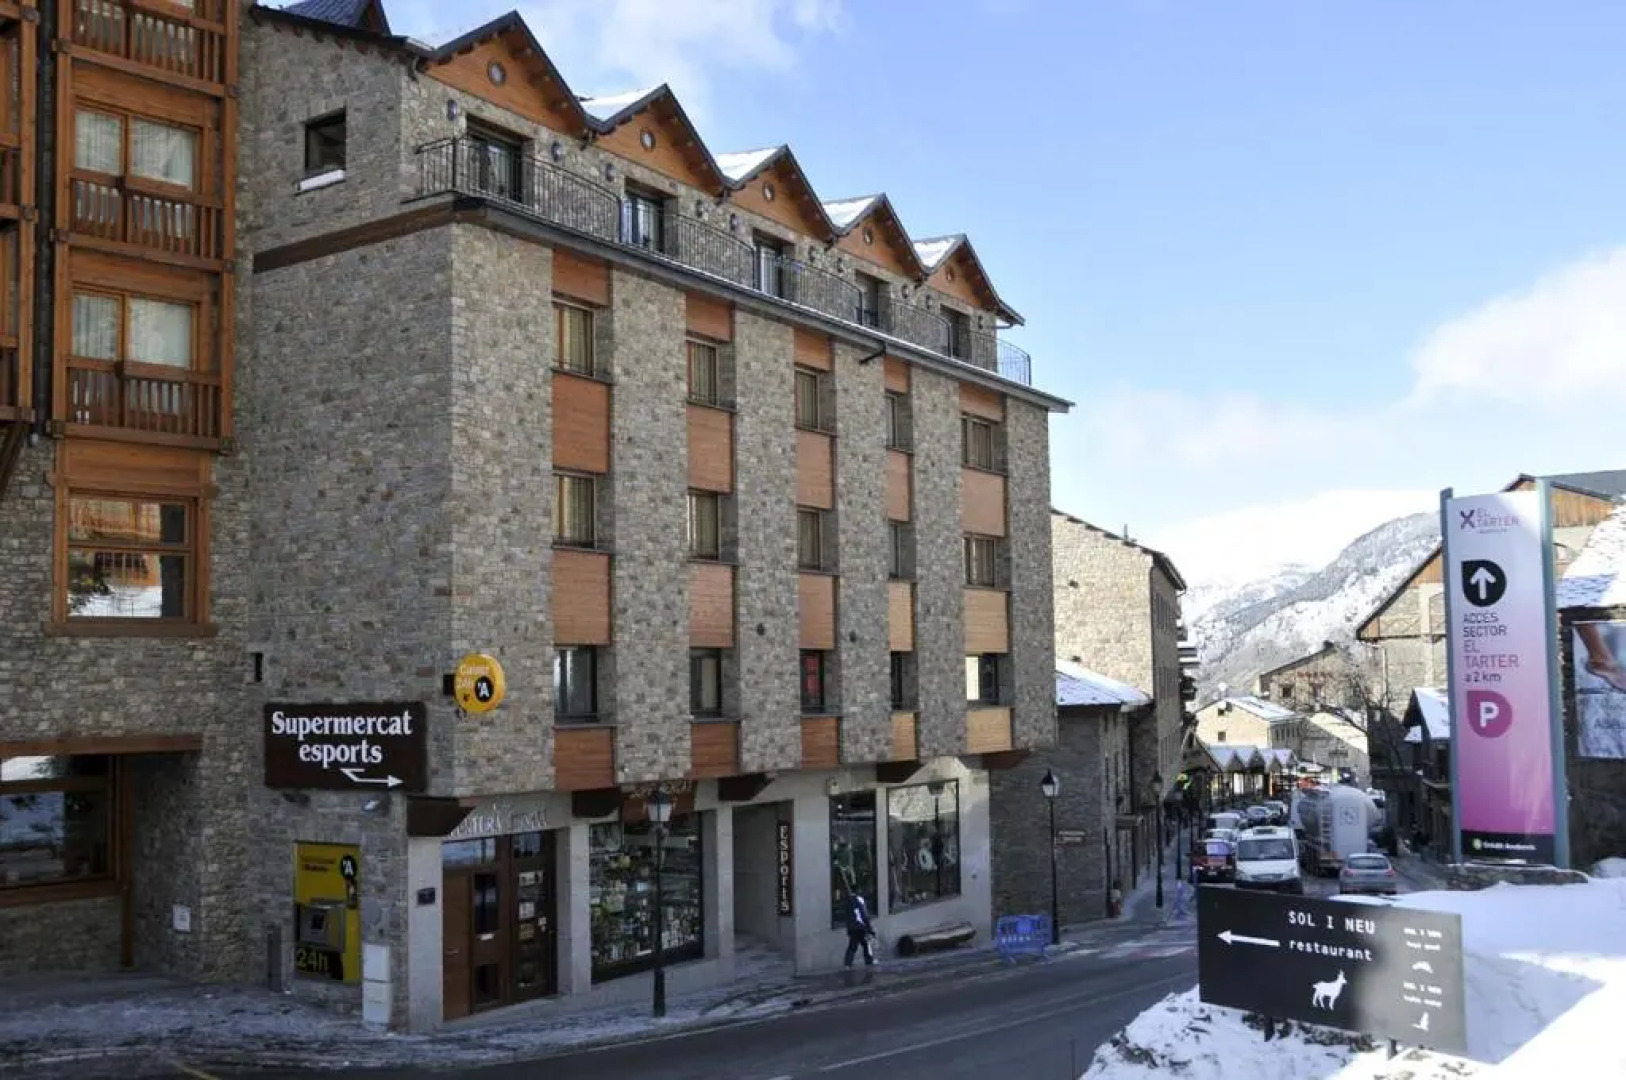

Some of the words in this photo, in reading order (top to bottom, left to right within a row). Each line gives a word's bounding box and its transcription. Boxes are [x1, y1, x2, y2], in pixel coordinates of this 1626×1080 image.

[1463, 624, 1508, 638] SECTOR
[1463, 639, 1481, 654] EL
[1464, 653, 1520, 669] TARTER
[1473, 671, 1481, 682] 2
[1482, 671, 1502, 683] km
[272, 709, 413, 741] Supermercat
[1480, 701, 1500, 728] P
[299, 739, 382, 769] esports
[1288, 910, 1316, 927] SOL
[1326, 915, 1335, 930] I
[1344, 917, 1376, 935] NEU
[295, 946, 329, 973] 24h
[1289, 939, 1373, 962] restaurant
